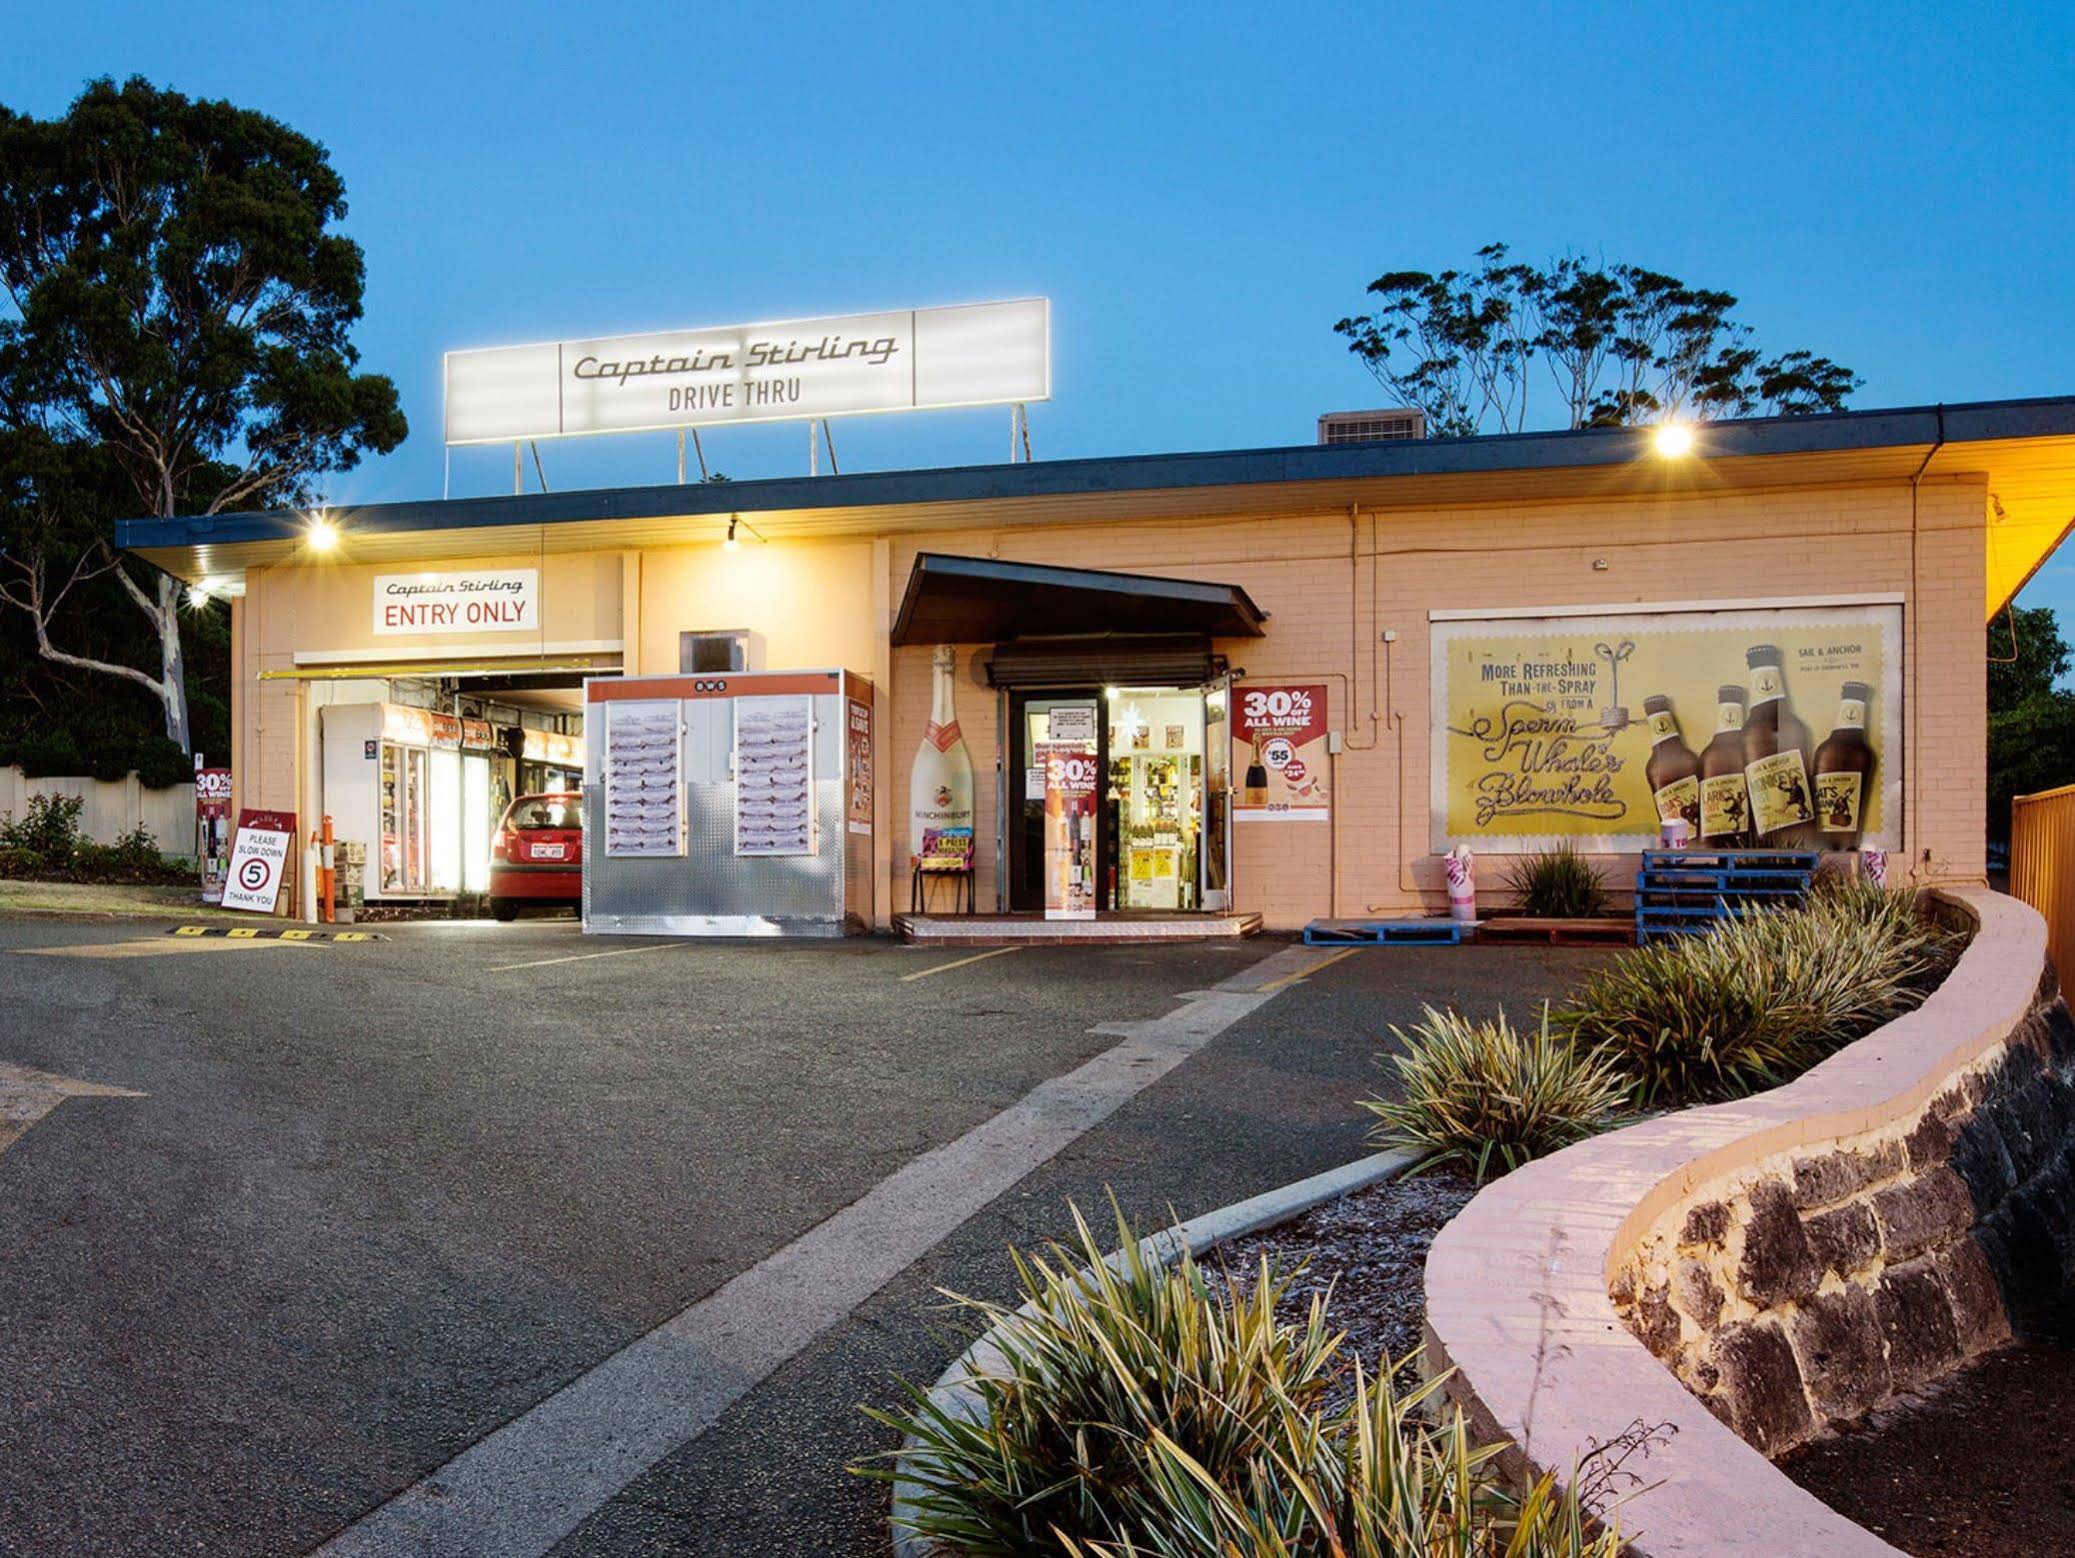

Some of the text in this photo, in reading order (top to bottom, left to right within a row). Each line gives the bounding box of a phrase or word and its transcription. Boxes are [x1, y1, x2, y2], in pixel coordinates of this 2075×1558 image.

[574, 336, 899, 386] Captain Stirling
[669, 377, 800, 412] DRIVE THRU
[386, 579, 523, 598] Captain Stirling
[385, 600, 526, 626] ENTRY ONLY
[1481, 662, 1597, 681] MORE REFRESHING
[1243, 690, 1312, 718] 30%
[1561, 698, 1594, 710] FROM A
[1244, 716, 1312, 728] ALL WINE
[1046, 759, 1097, 781] 30%
[196, 773, 232, 791] 30%
[1047, 781, 1097, 790] ALL WINE
[249, 834, 277, 846] PLEASE
[238, 844, 283, 857] SLOW DOWN
[246, 864, 262, 884] 5
[229, 891, 273, 905] THANK YOU
